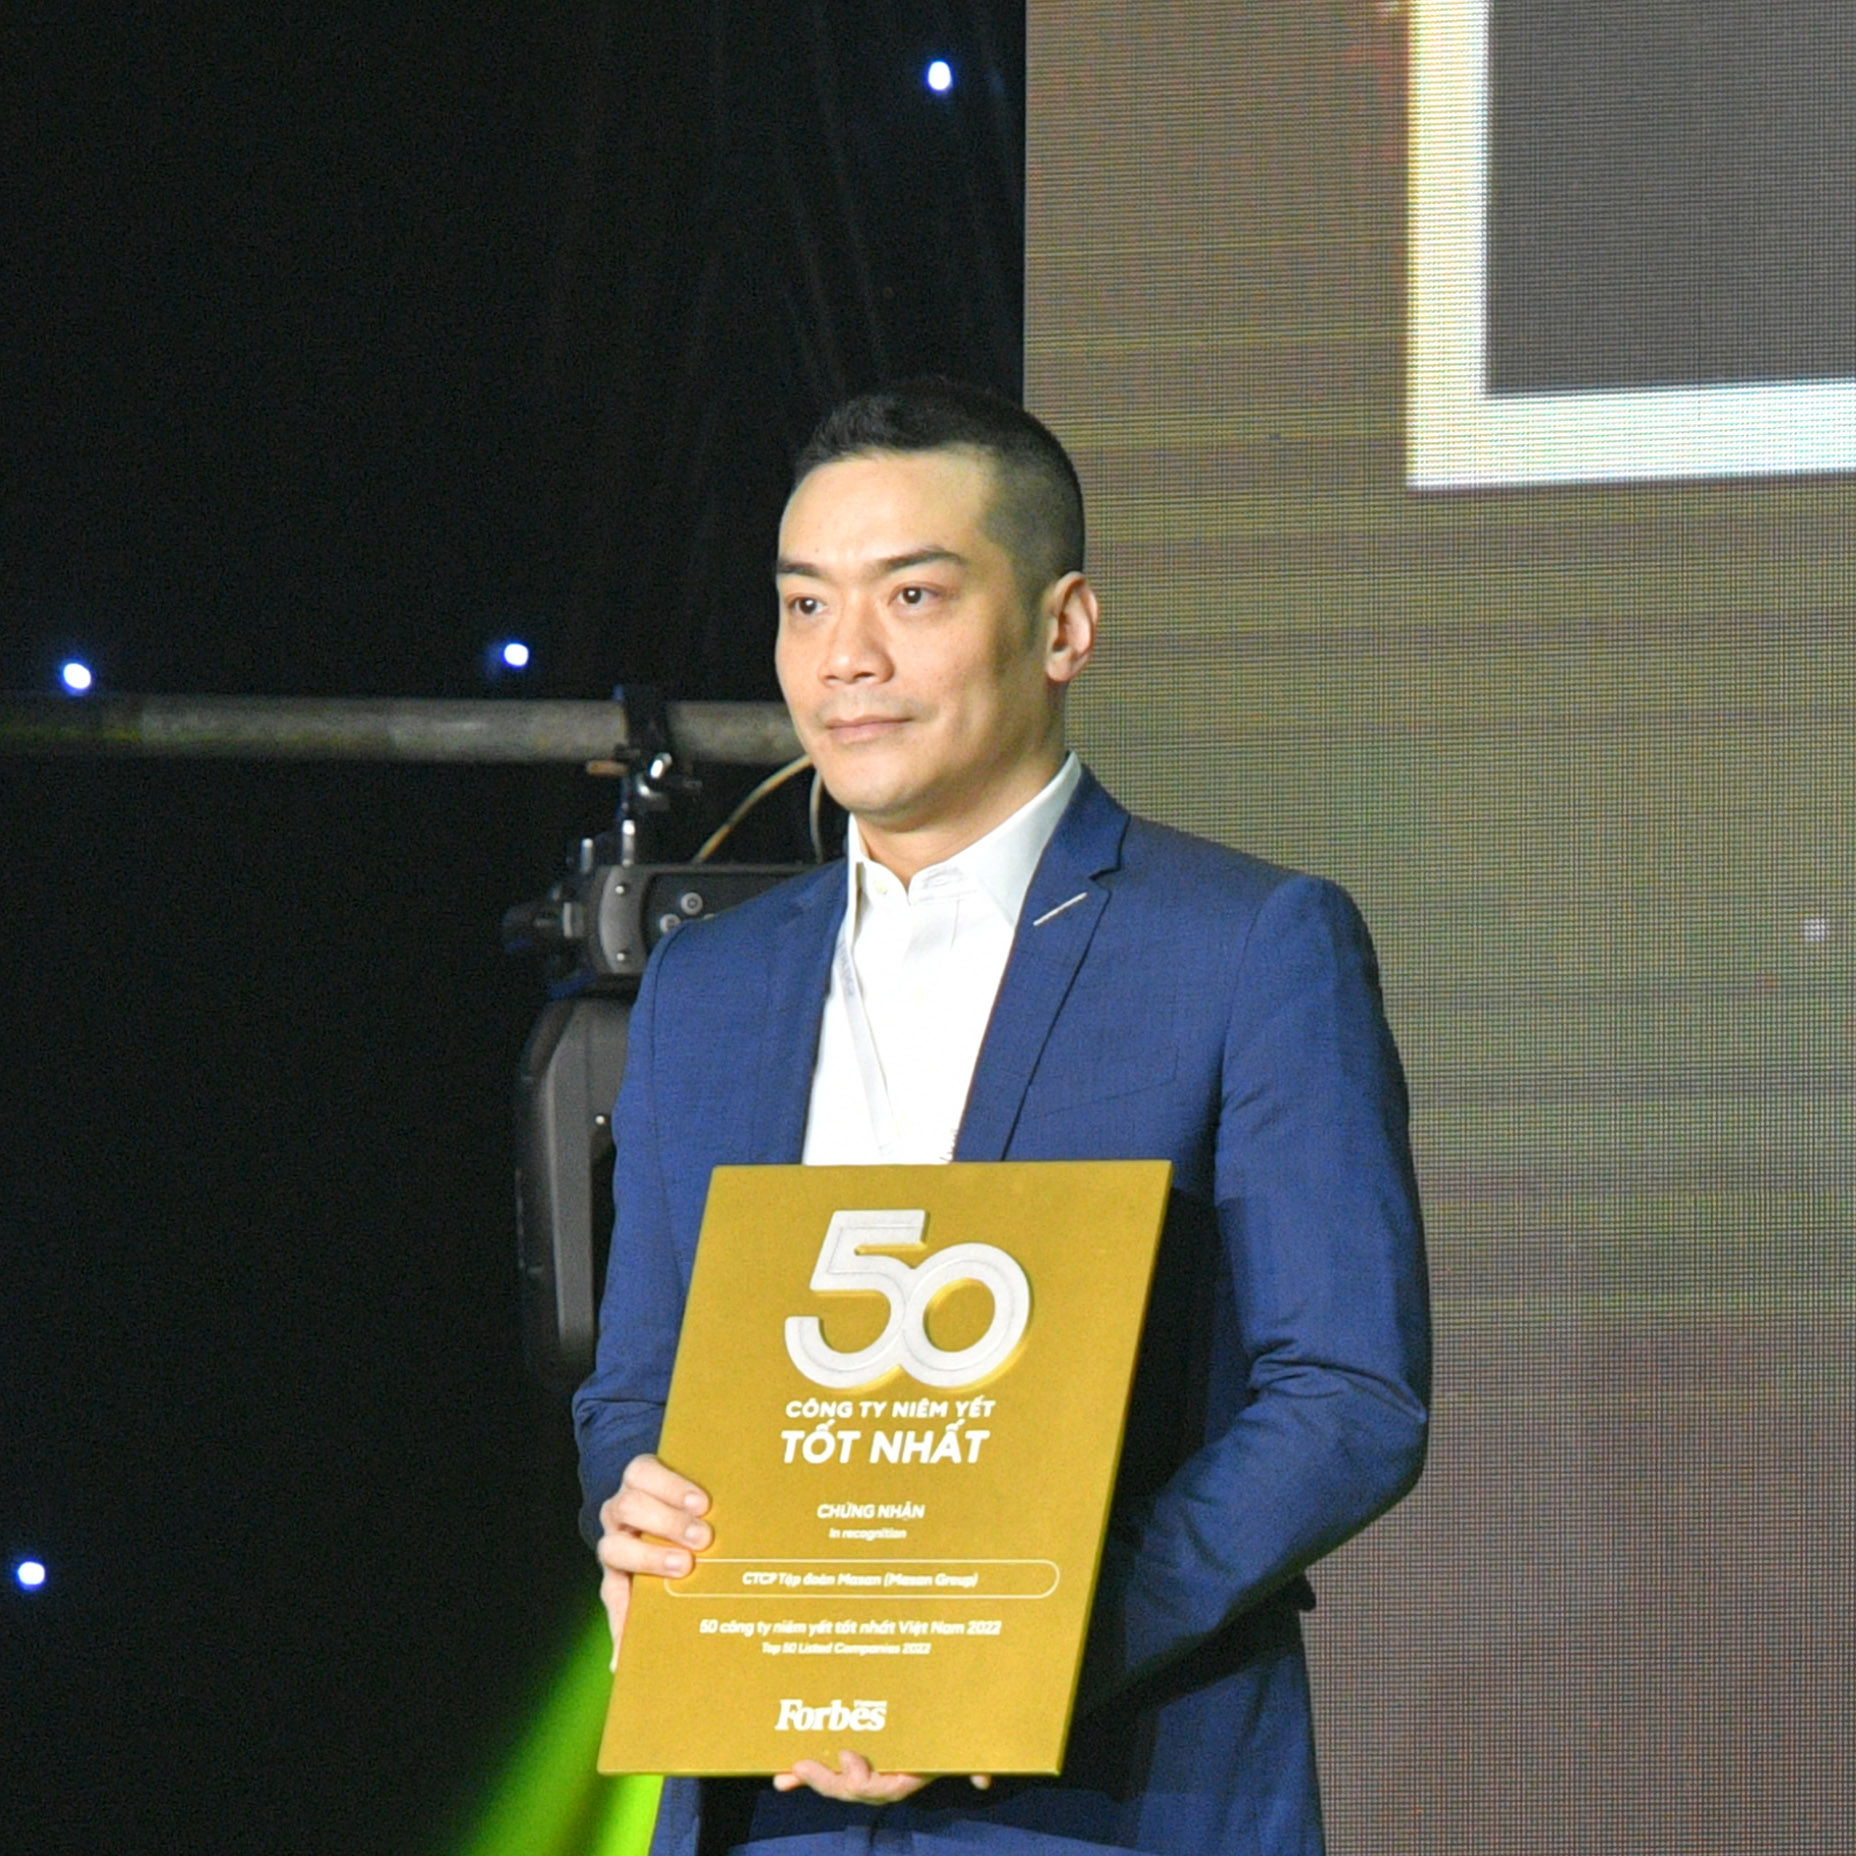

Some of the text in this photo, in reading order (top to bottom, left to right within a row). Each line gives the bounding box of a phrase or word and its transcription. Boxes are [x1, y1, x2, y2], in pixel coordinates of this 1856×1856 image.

[784, 1208, 1031, 1390] 50
[785, 1395, 996, 1418] CÔNG TY NIÊM YẾT
[780, 1418, 991, 1464] TỐT NHẤT
[817, 1500, 926, 1520] CHỨNG NHẬN
[699, 1618, 718, 1634] 50
[931, 1620, 965, 1634] Nam
[967, 1620, 1002, 1635] 2022
[774, 1698, 887, 1731] Forbes
